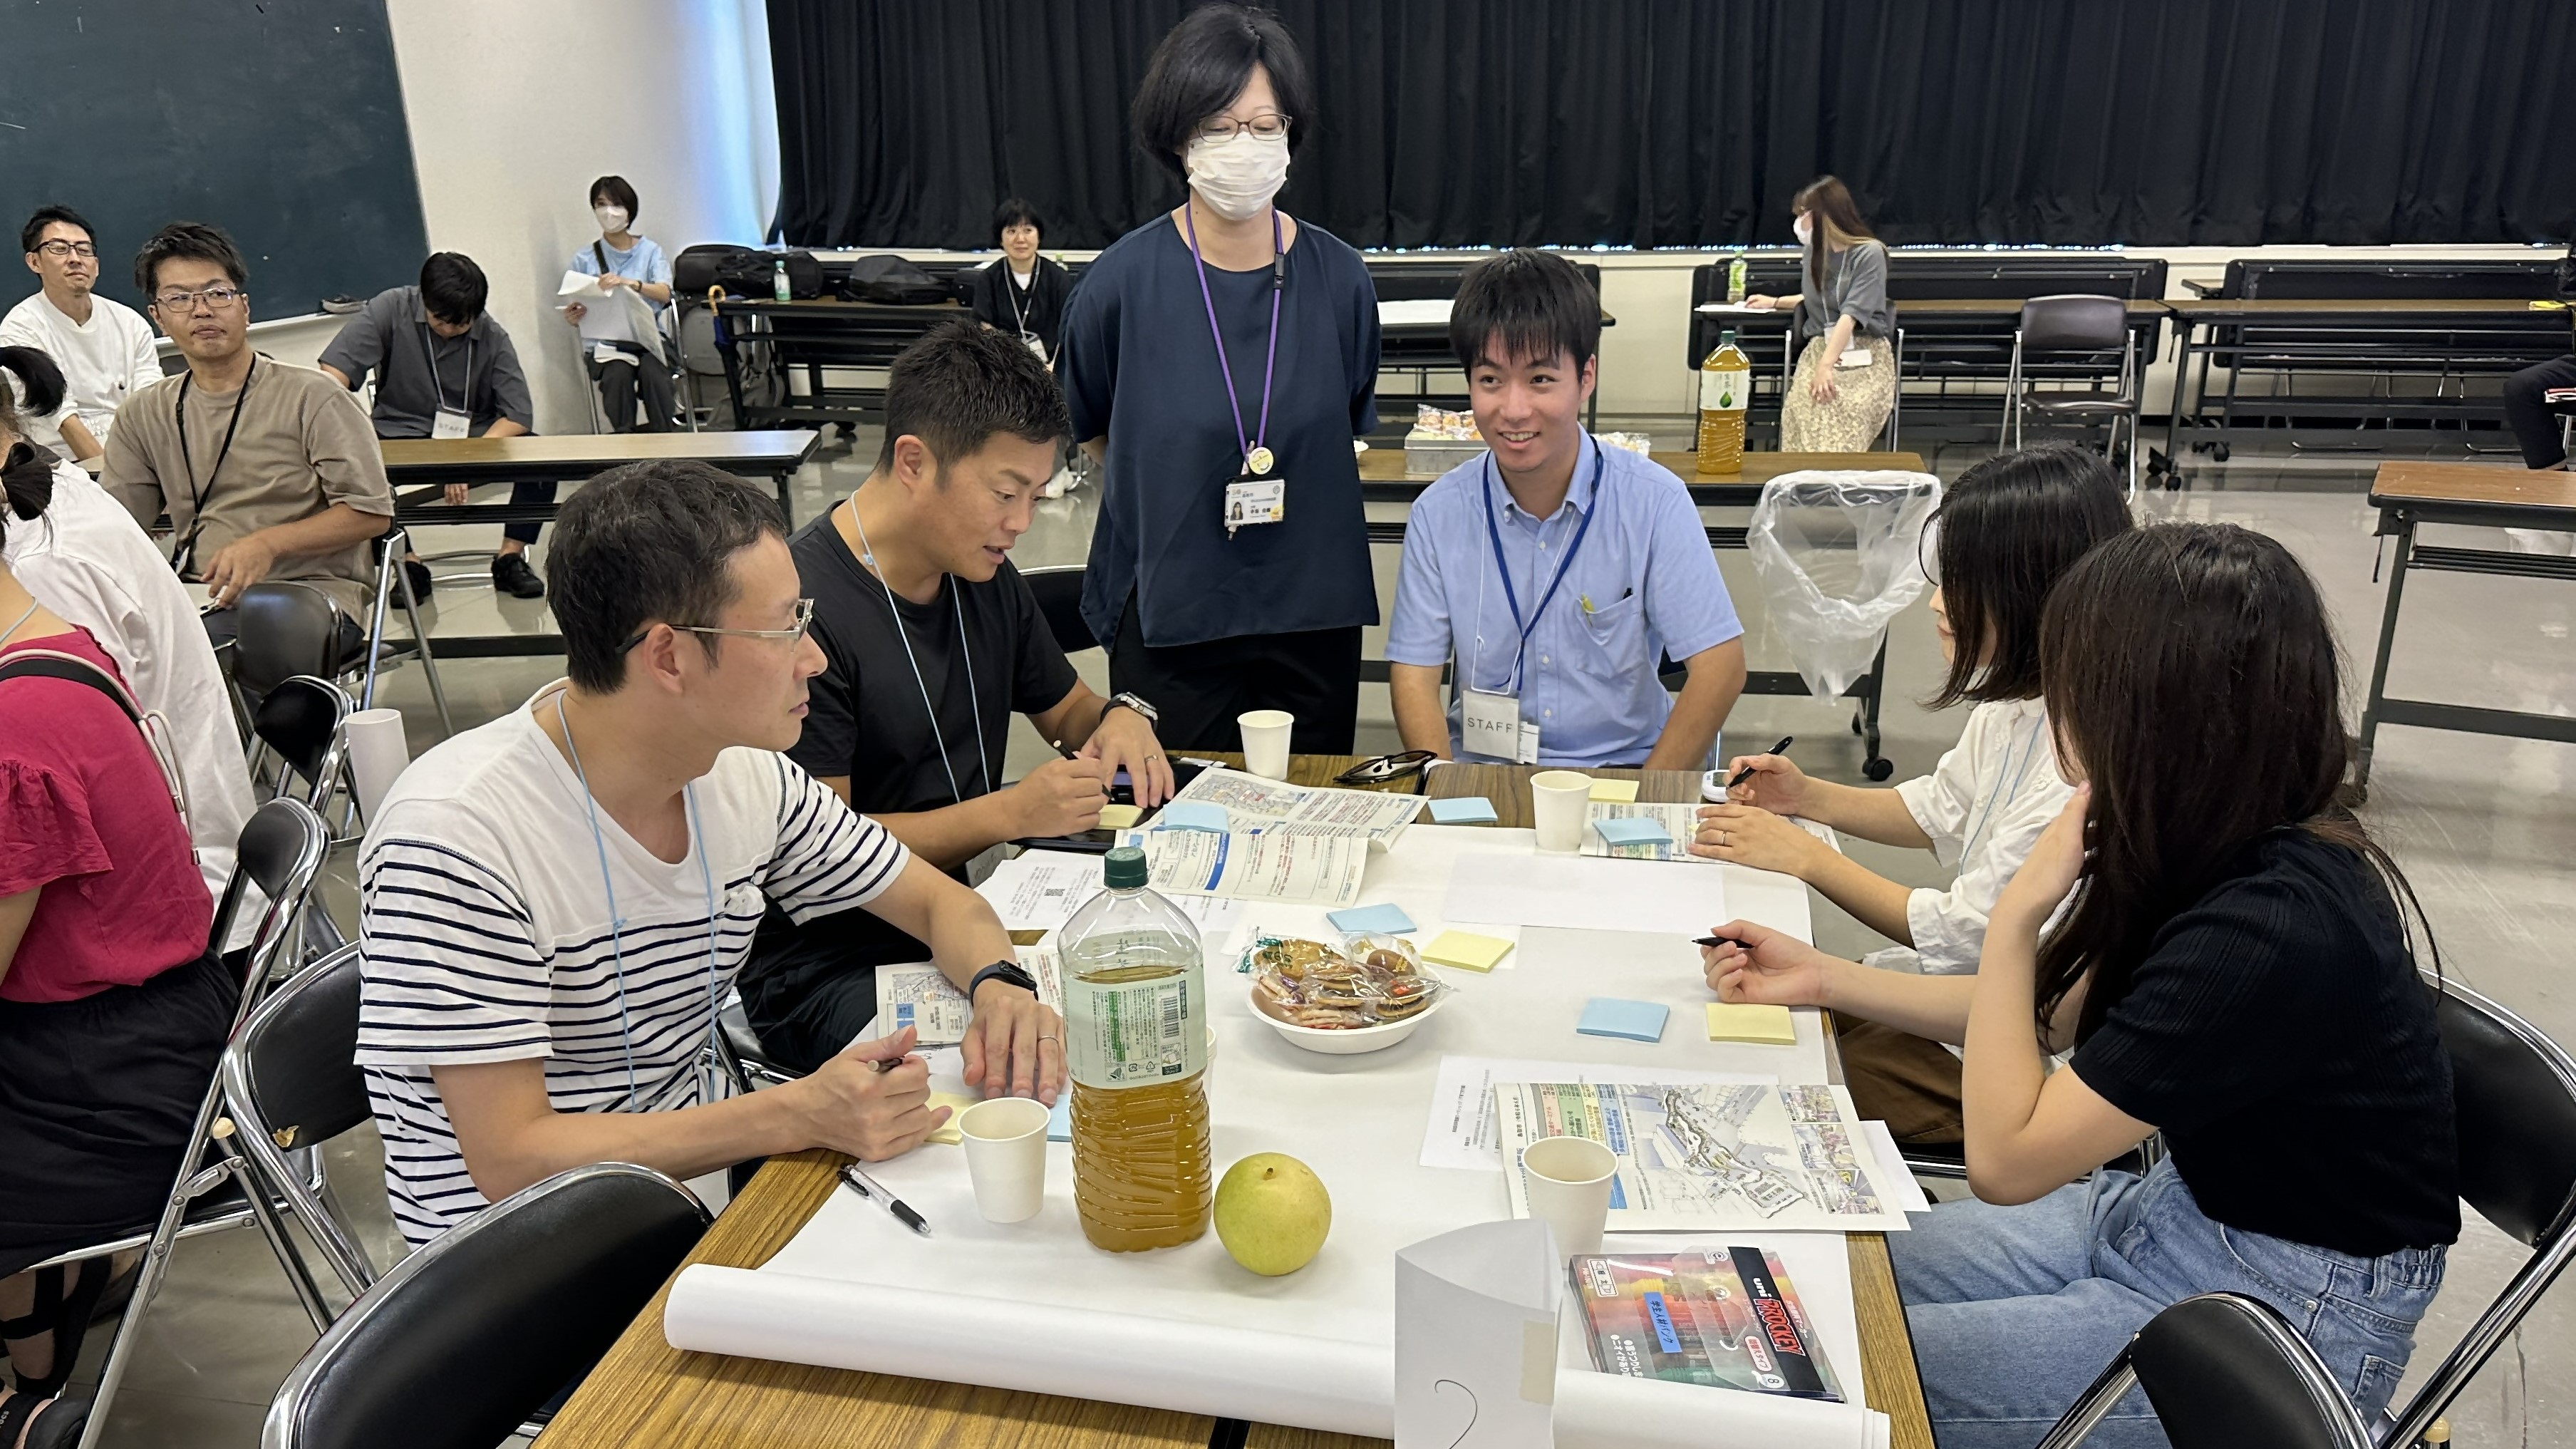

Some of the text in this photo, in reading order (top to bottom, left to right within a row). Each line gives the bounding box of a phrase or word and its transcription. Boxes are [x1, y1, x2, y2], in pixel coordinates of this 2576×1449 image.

[1467, 717, 1513, 733] STAFF
[1753, 1277, 1806, 1357] uni PROCKEY
